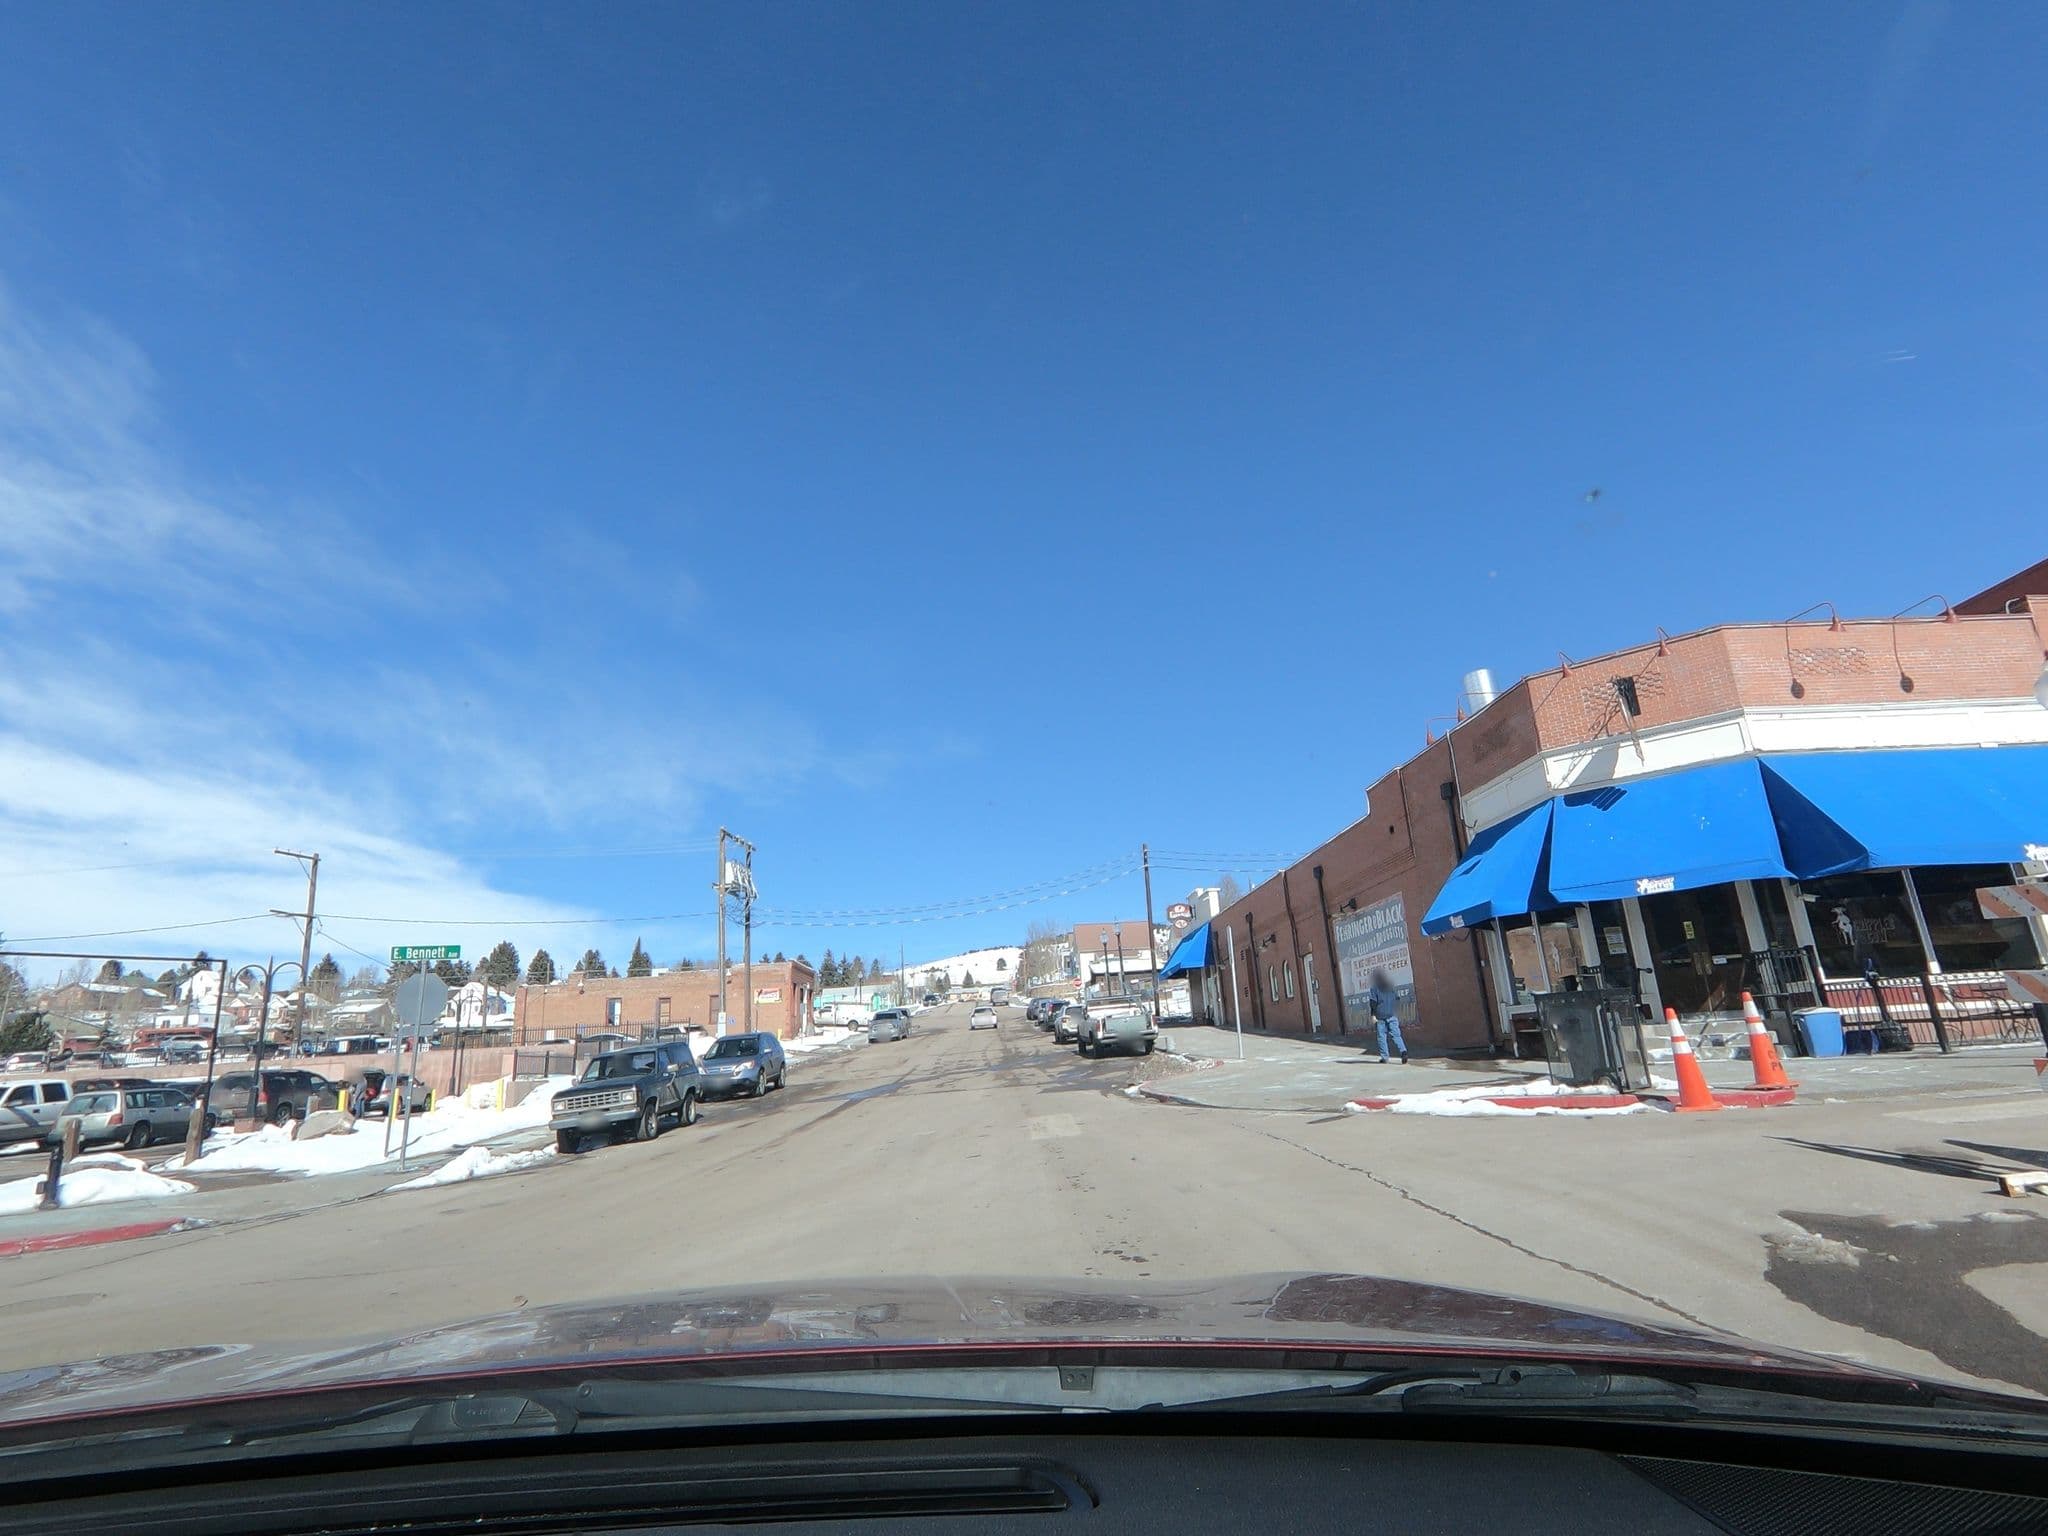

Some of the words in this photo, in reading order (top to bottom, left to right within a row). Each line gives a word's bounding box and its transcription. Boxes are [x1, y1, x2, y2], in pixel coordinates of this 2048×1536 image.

[1375, 903, 1404, 929] BLACK
[394, 947, 402, 959] E.
[406, 946, 445, 959] Bennett
